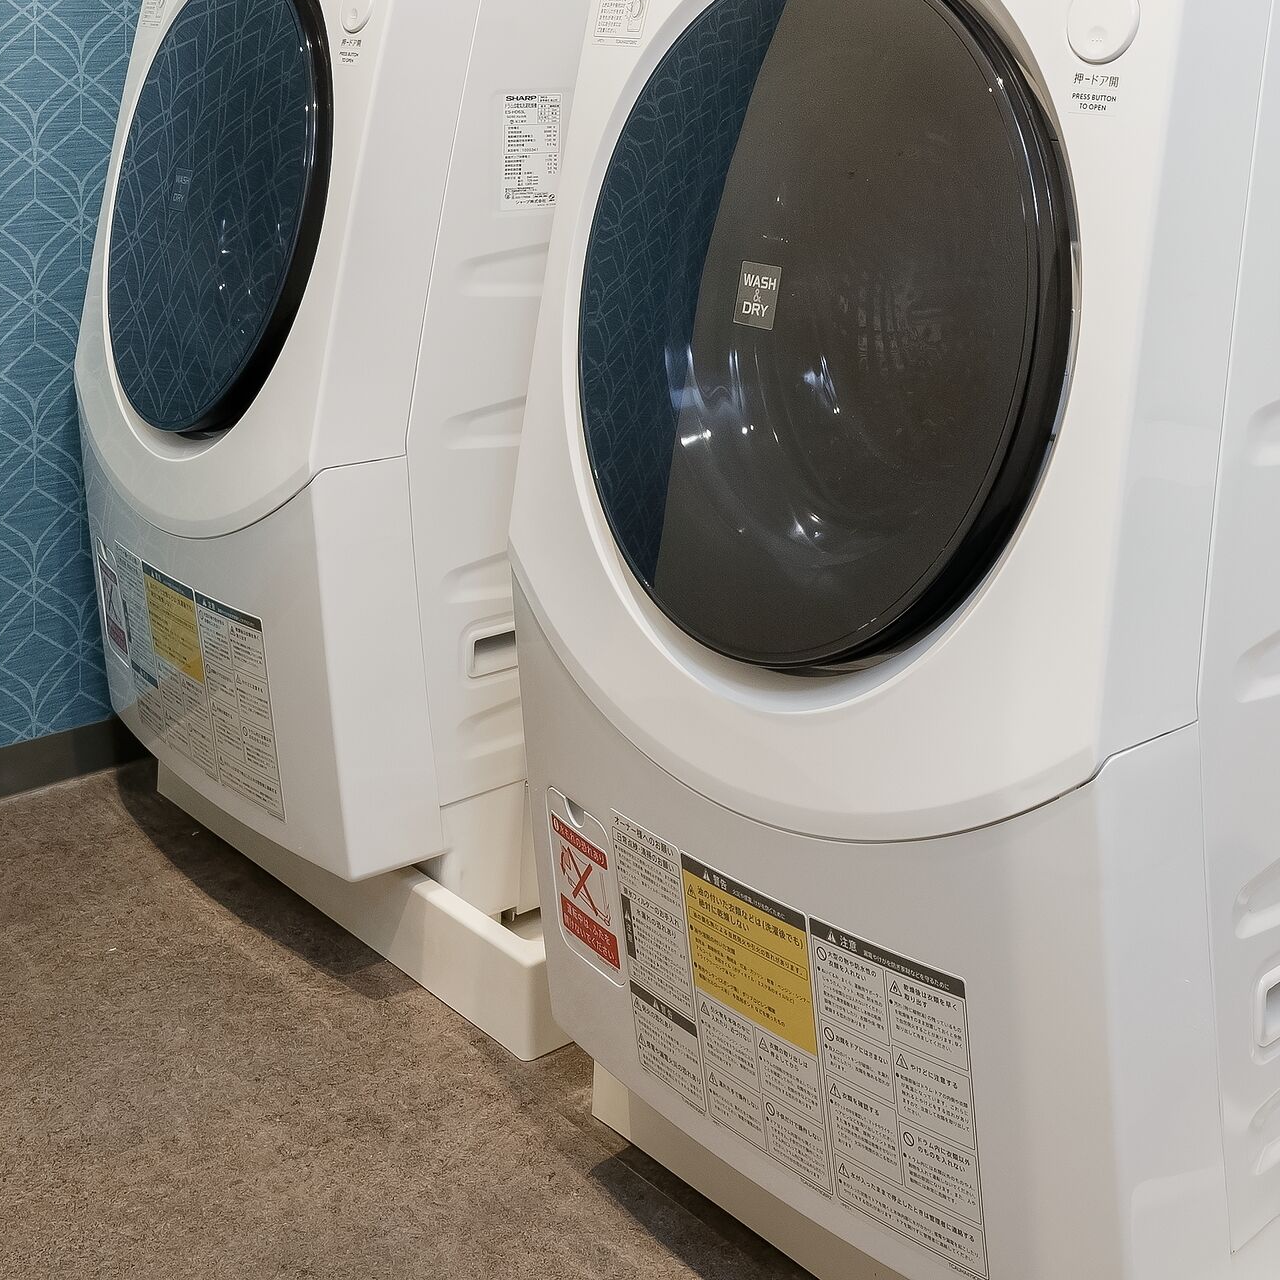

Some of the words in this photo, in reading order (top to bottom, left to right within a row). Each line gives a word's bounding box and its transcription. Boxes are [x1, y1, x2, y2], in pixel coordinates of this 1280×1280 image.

[1072, 93, 1091, 101] PRESS
[1091, 94, 1117, 102] BUTTON
[1079, 102, 1088, 110] TO
[1088, 103, 1107, 111] OPEN
[744, 273, 777, 291] WASH
[753, 288, 761, 303] &
[742, 301, 769, 318] DRY
[613, 814, 673, 859] オーナー様へのお願い
[712, 873, 727, 891] 警告
[698, 896, 749, 934] 絶対に乾燥しない
[839, 934, 857, 953] 注意
[827, 958, 866, 982] 衣類を入れない
[902, 981, 957, 1013] 乾燥後は衣類を早く
[903, 991, 928, 1009] 取り出す
[768, 1041, 808, 1069] 衣類の取り出しは
[769, 1049, 799, 1073] 停止してから
[834, 1033, 889, 1067] 衣類をドアにはさまない
[909, 1060, 958, 1091] やけどに注意する
[841, 1090, 879, 1117] 衣類を確認する
[916, 1133, 970, 1169] ドラム内に衣類以外
[917, 1142, 966, 1176] のものを入れない
[849, 1166, 975, 1247] 水が入ったままで停止したときは管理者に連絡する
